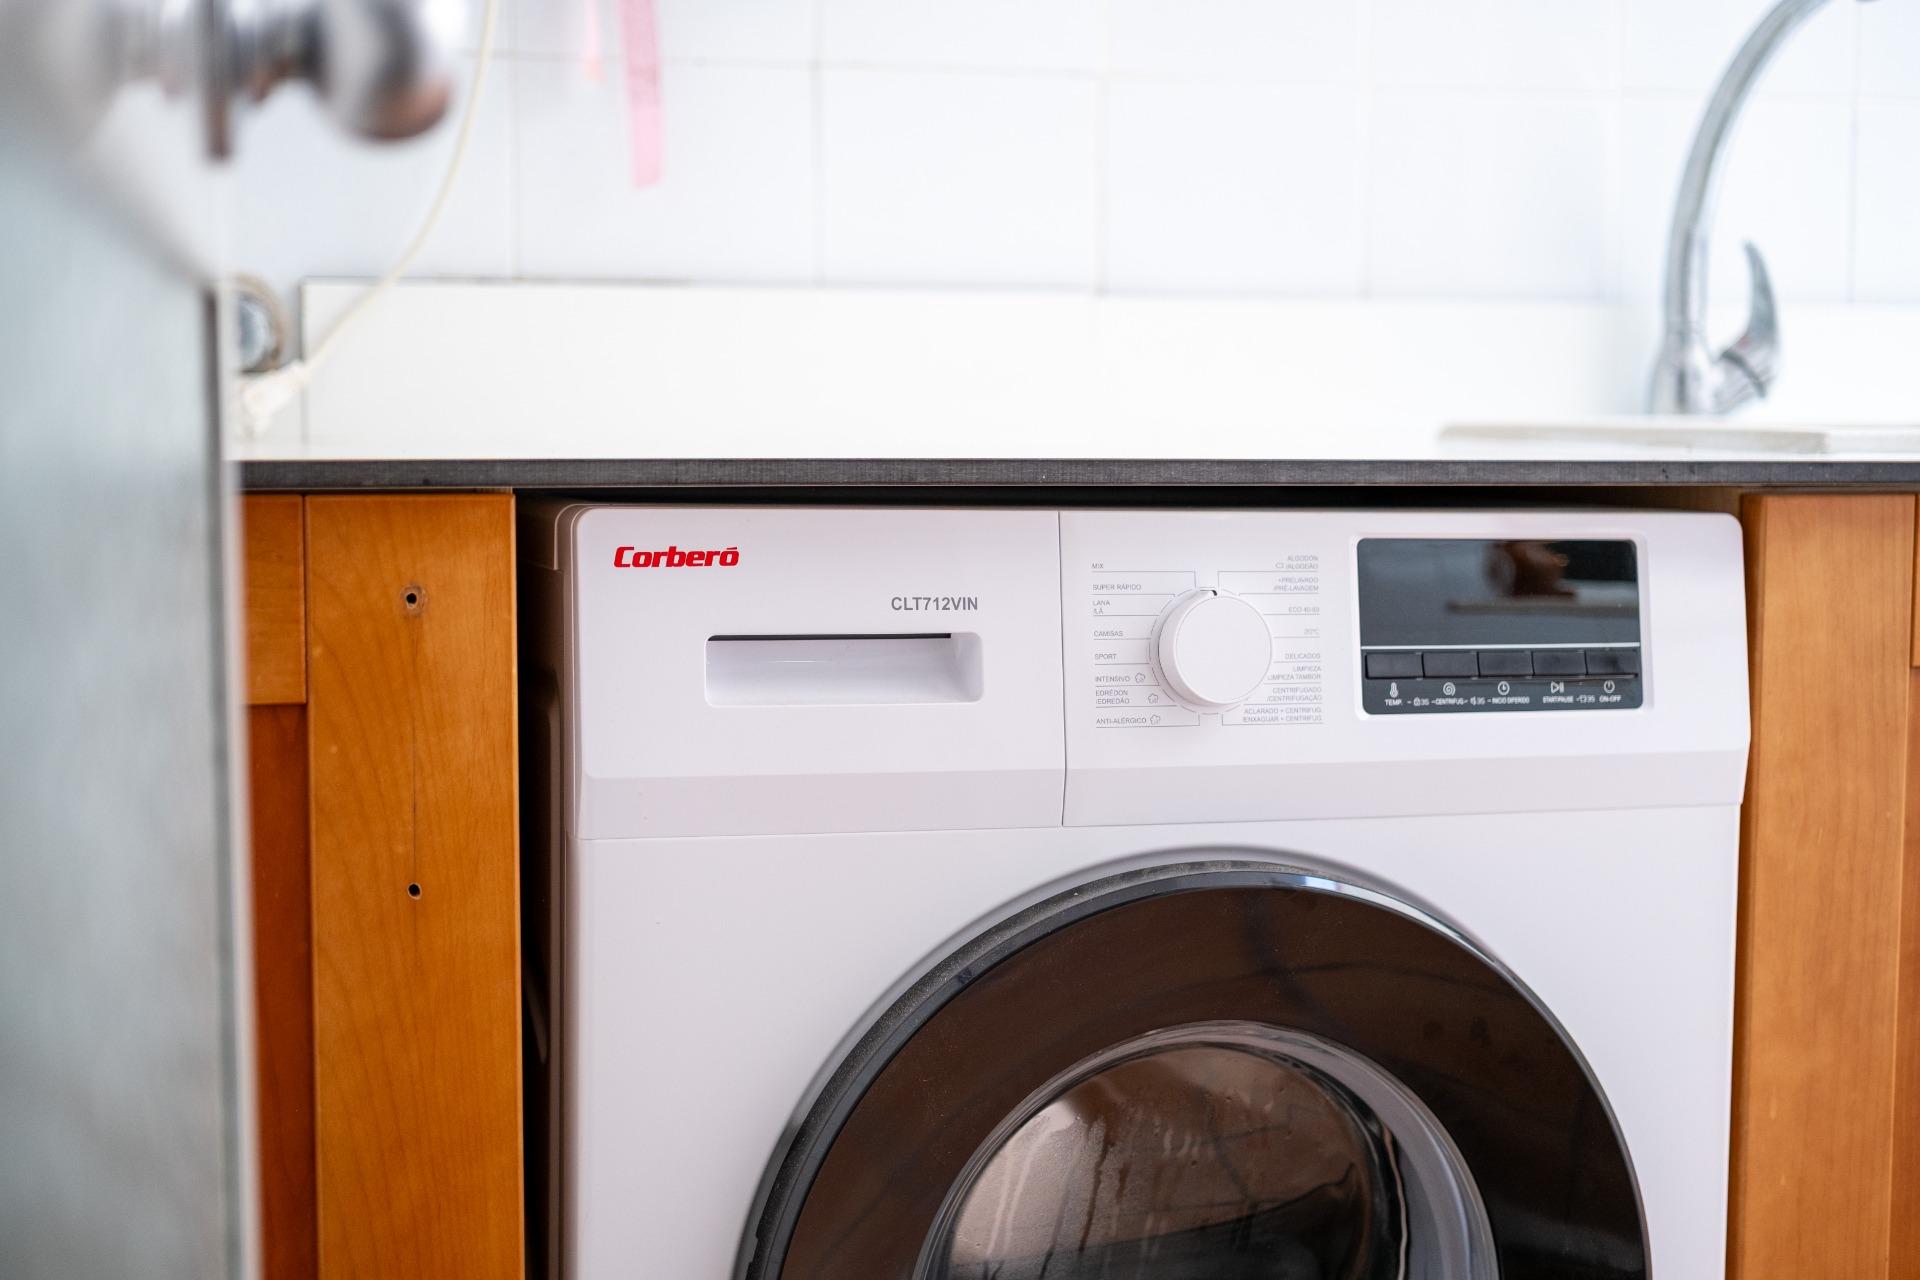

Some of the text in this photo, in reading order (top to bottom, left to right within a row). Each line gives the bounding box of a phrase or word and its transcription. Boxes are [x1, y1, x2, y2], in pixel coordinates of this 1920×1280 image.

[613, 546, 739, 568] Corberó
[1116, 583, 1142, 591] RÁPIDO
[891, 596, 979, 612] CLT712VIN
